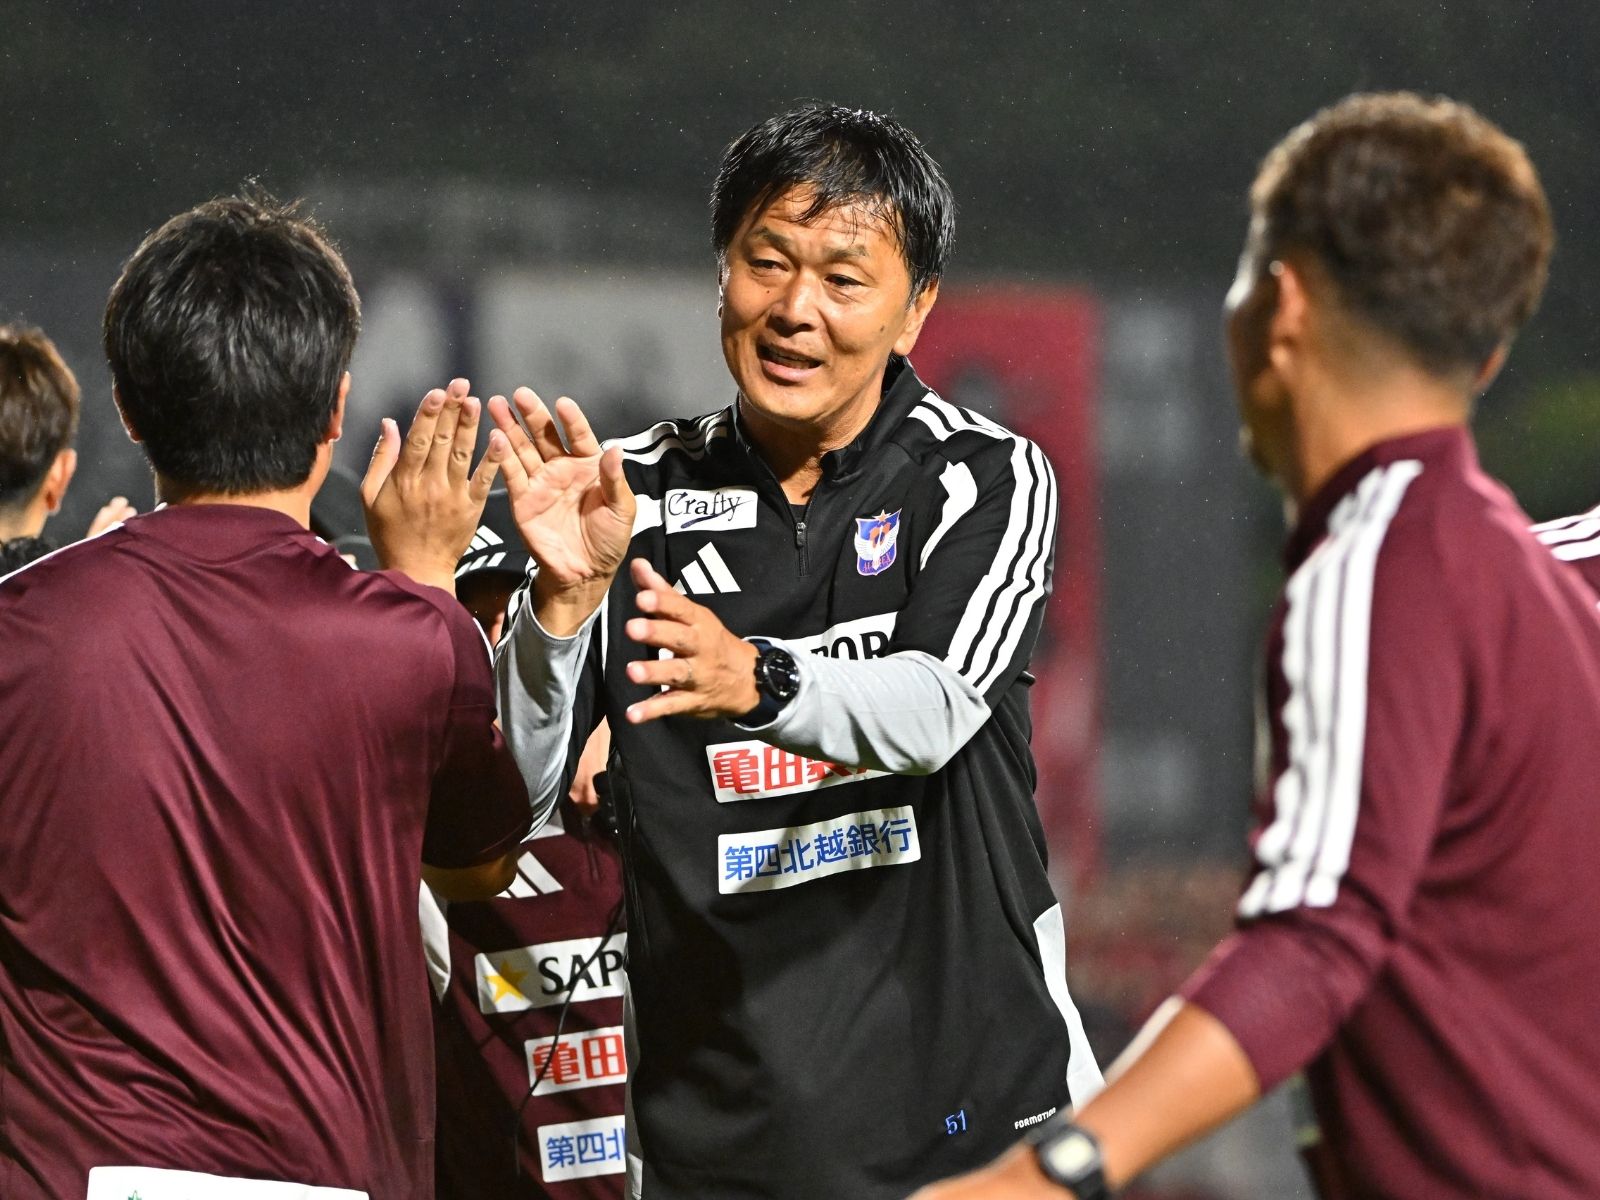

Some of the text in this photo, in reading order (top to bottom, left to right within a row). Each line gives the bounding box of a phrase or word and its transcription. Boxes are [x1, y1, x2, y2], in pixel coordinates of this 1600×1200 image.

[667, 491, 742, 522] Crafty
[810, 630, 889, 660] OR
[724, 817, 913, 881] 第四北越銀行
[532, 1034, 627, 1085] 亀田
[944, 1109, 968, 1136] 51
